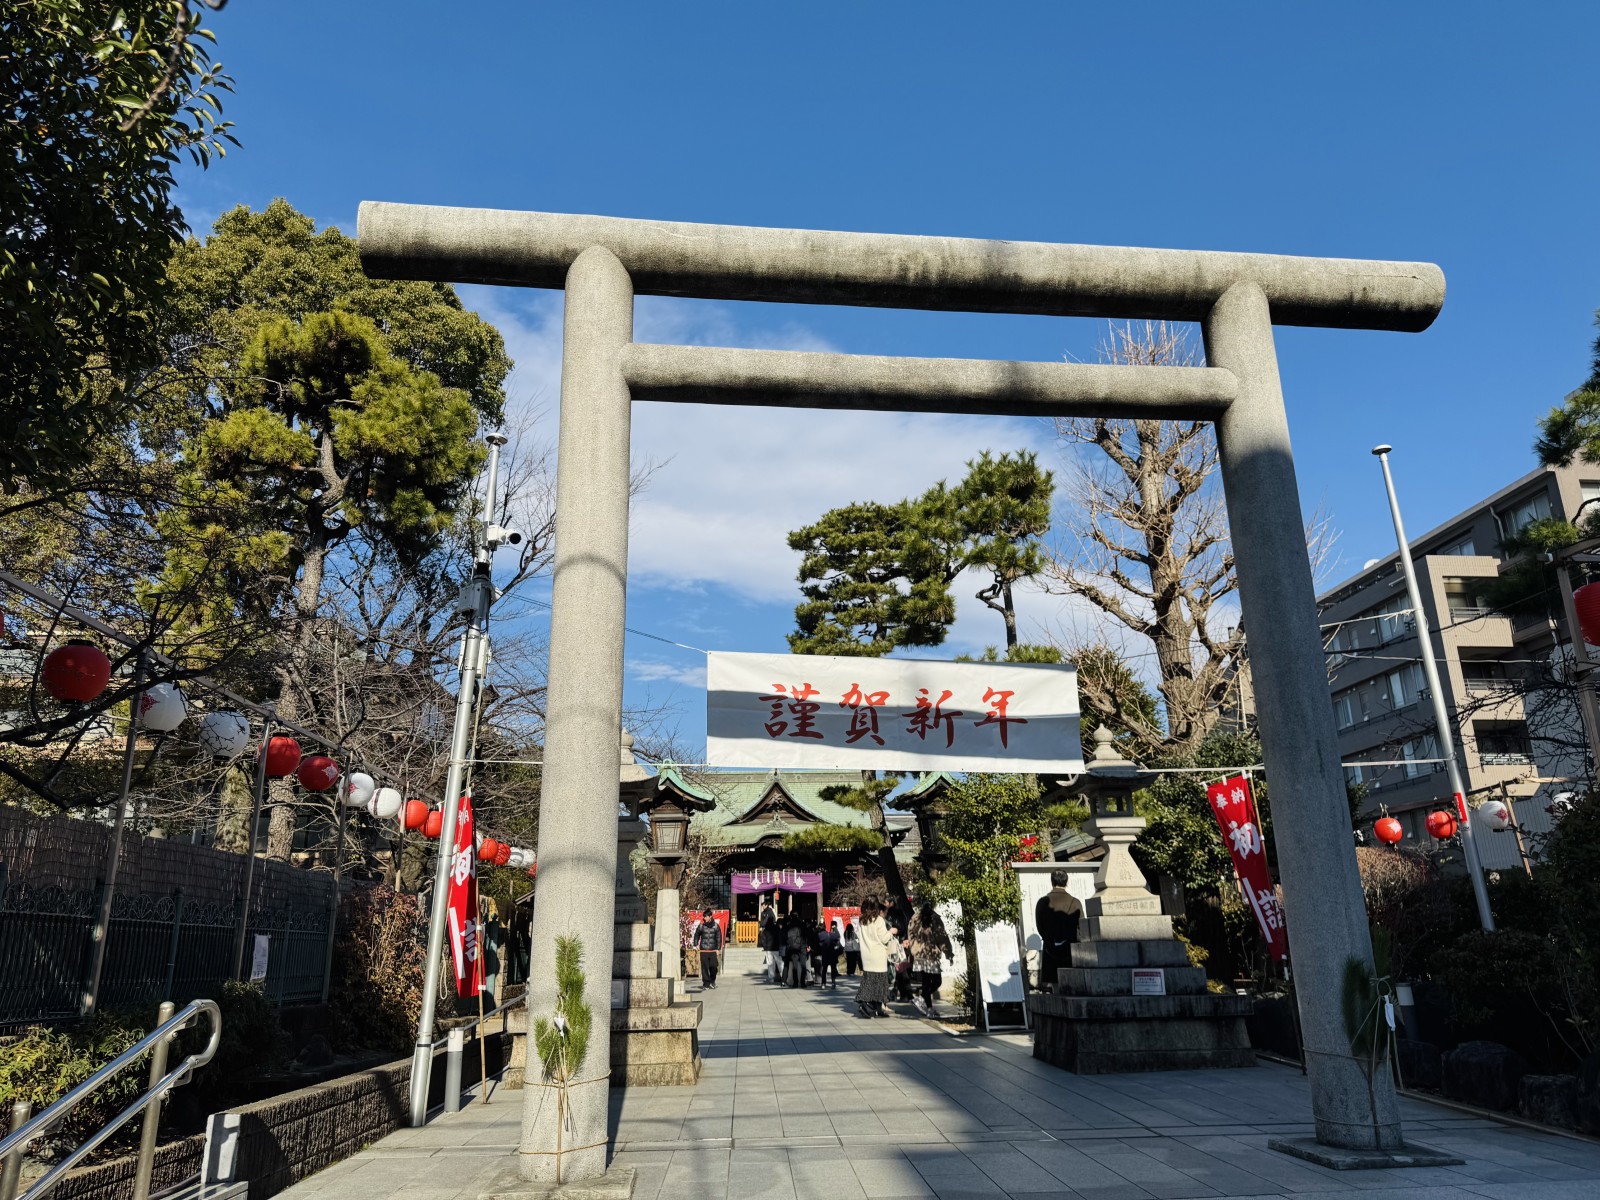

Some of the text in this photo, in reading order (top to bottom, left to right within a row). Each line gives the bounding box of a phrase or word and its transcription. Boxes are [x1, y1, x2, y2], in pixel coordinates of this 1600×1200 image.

[757, 682, 1028, 749] 謹賀新年
[1215, 786, 1246, 811] 奉納
